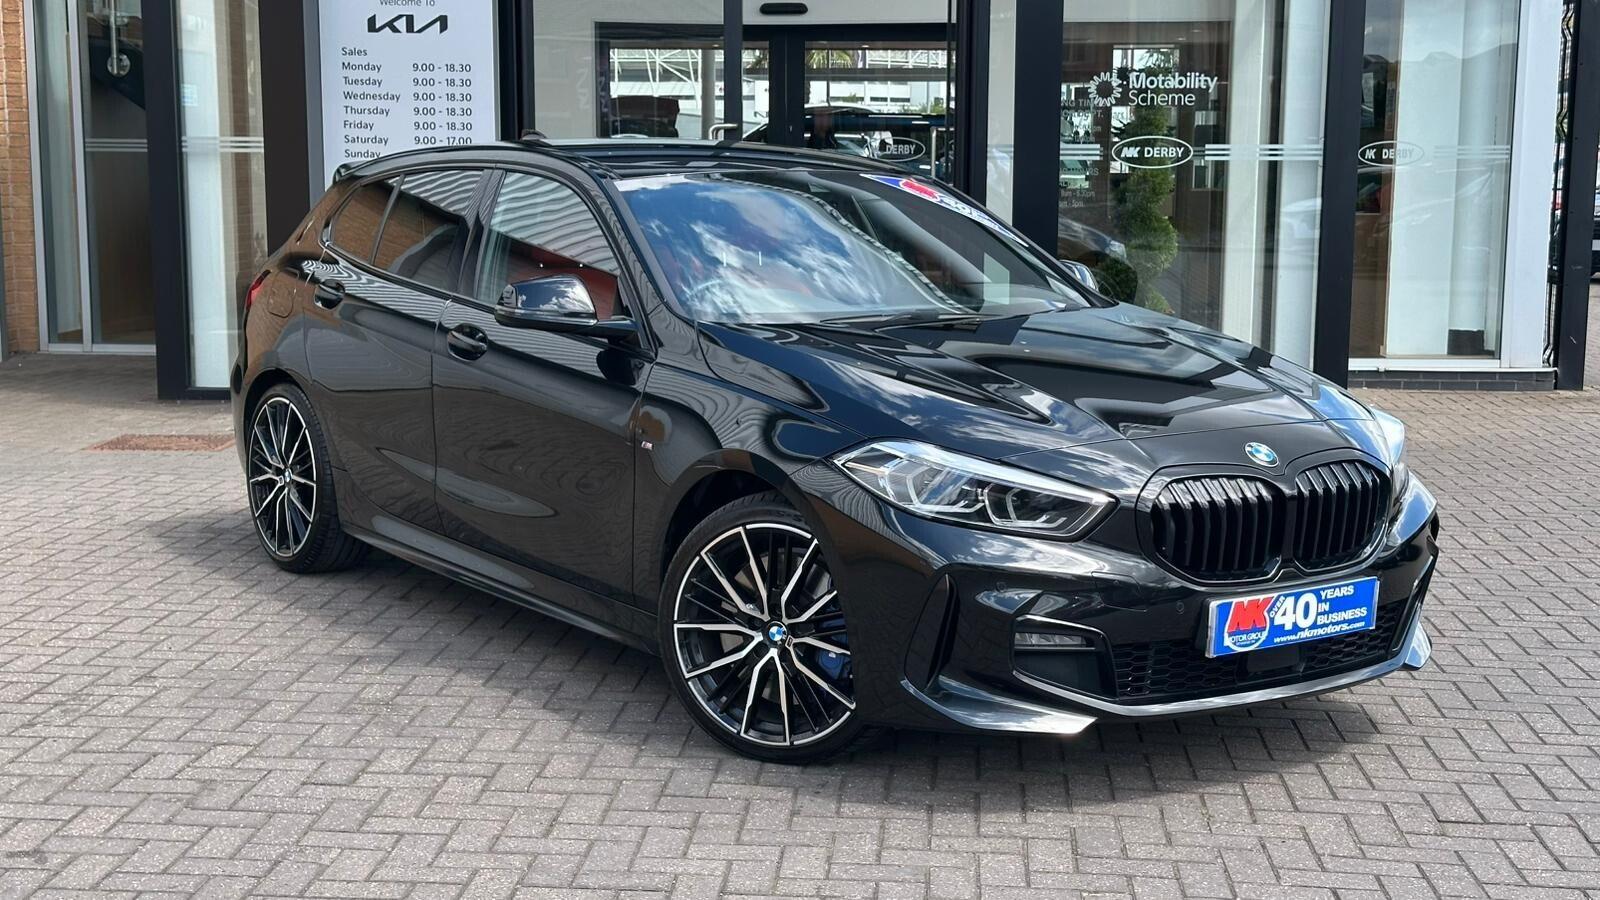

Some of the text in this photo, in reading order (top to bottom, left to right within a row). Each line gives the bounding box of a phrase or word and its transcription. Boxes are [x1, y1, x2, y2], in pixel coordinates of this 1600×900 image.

[367, 14, 448, 34] KIA
[341, 47, 367, 56] Sales
[342, 62, 382, 73] Monday
[412, 63, 434, 72] 9.00
[445, 63, 471, 73] 18.30
[343, 77, 383, 88] Tuesday
[412, 78, 434, 87] 9.00
[445, 78, 472, 88] 18.30
[1128, 72, 1218, 93] Motability
[343, 91, 401, 102] Wednesday
[413, 93, 435, 101] 9.00
[446, 93, 472, 102] 18.30
[1128, 90, 1196, 106] Scheme
[344, 106, 390, 117] Thursday
[413, 107, 435, 116] 9.00
[446, 107, 472, 117] 18.30
[343, 120, 374, 131] Friday
[413, 122, 435, 130] 9.00
[446, 122, 472, 131] 18.30
[344, 135, 389, 146] Saturday
[414, 136, 436, 144] 9.00
[886, 144, 916, 154] DERBY
[1144, 147, 1184, 158] DERBY
[1319, 585, 1355, 600] YEARS
[1269, 595, 1286, 618] OVER
[1273, 592, 1318, 631] 40
[1317, 601, 1330, 613] IN
[1316, 606, 1368, 626] BUSINESS
[1273, 621, 1366, 643] www.nkmotors.com
